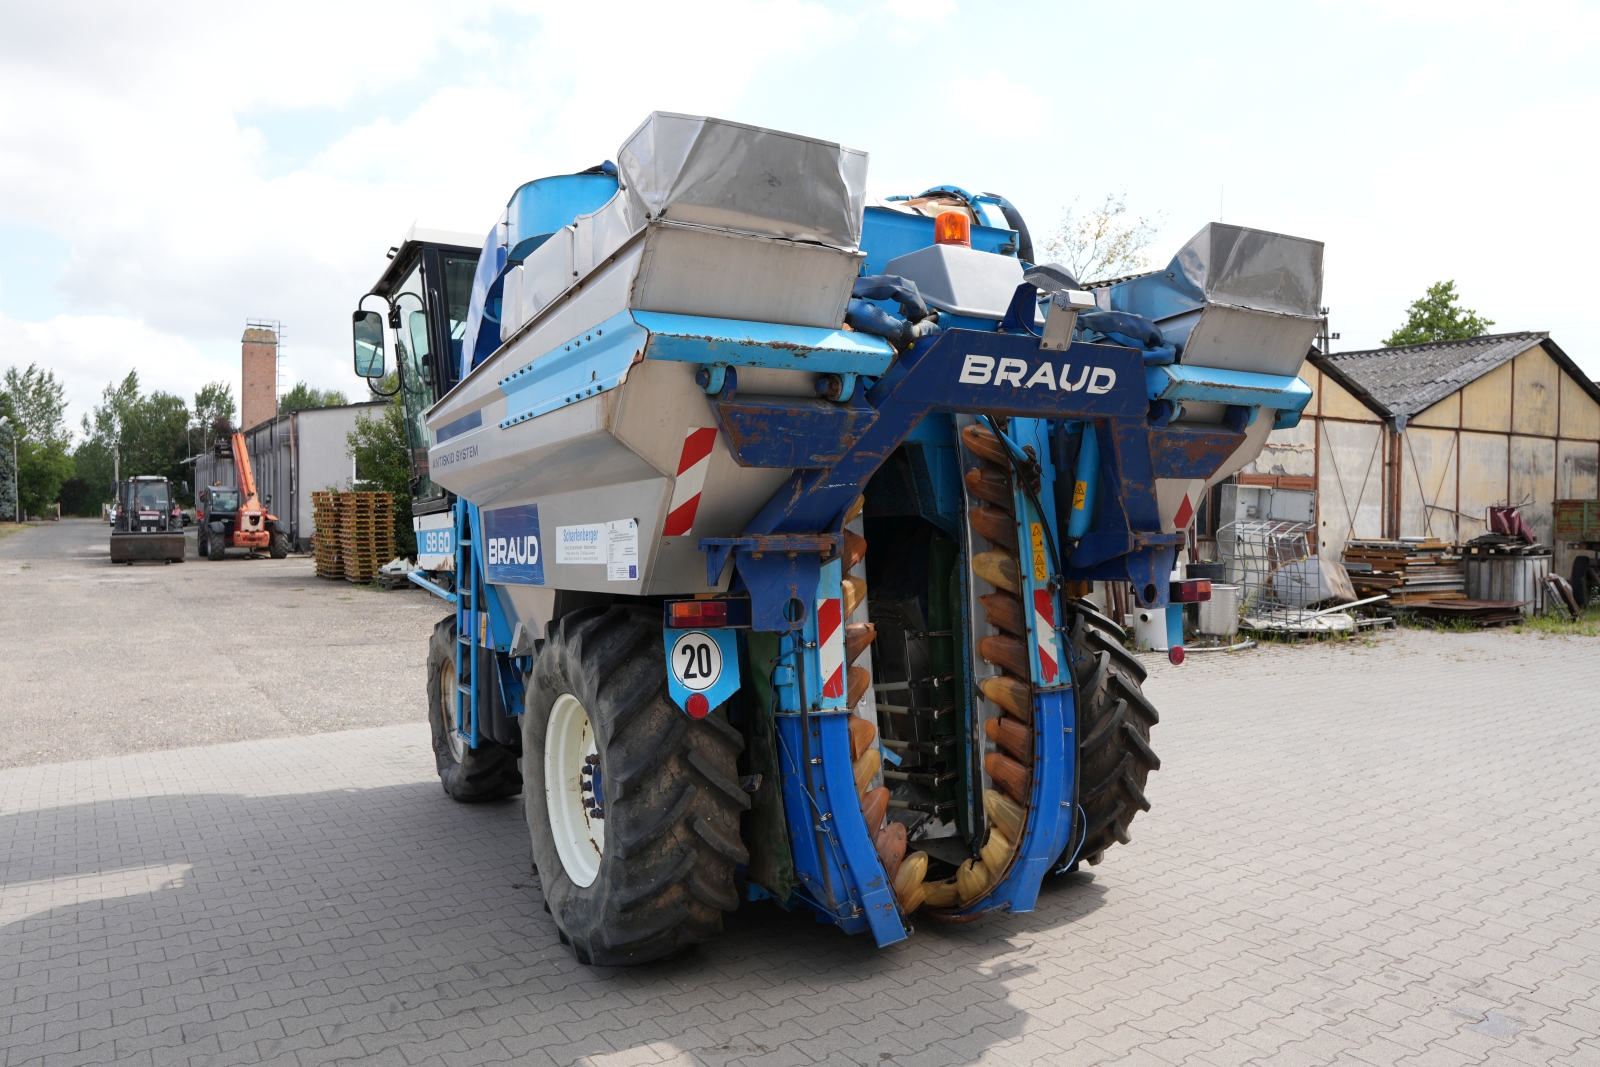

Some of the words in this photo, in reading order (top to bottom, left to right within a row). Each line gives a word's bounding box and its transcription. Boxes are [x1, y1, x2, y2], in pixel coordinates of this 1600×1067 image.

[958, 354, 1117, 395] BRAUD
[432, 452, 455, 469] ANTISKID
[455, 444, 479, 462] SYSTEM
[488, 535, 539, 565] BRAUD
[681, 643, 712, 680] 20
